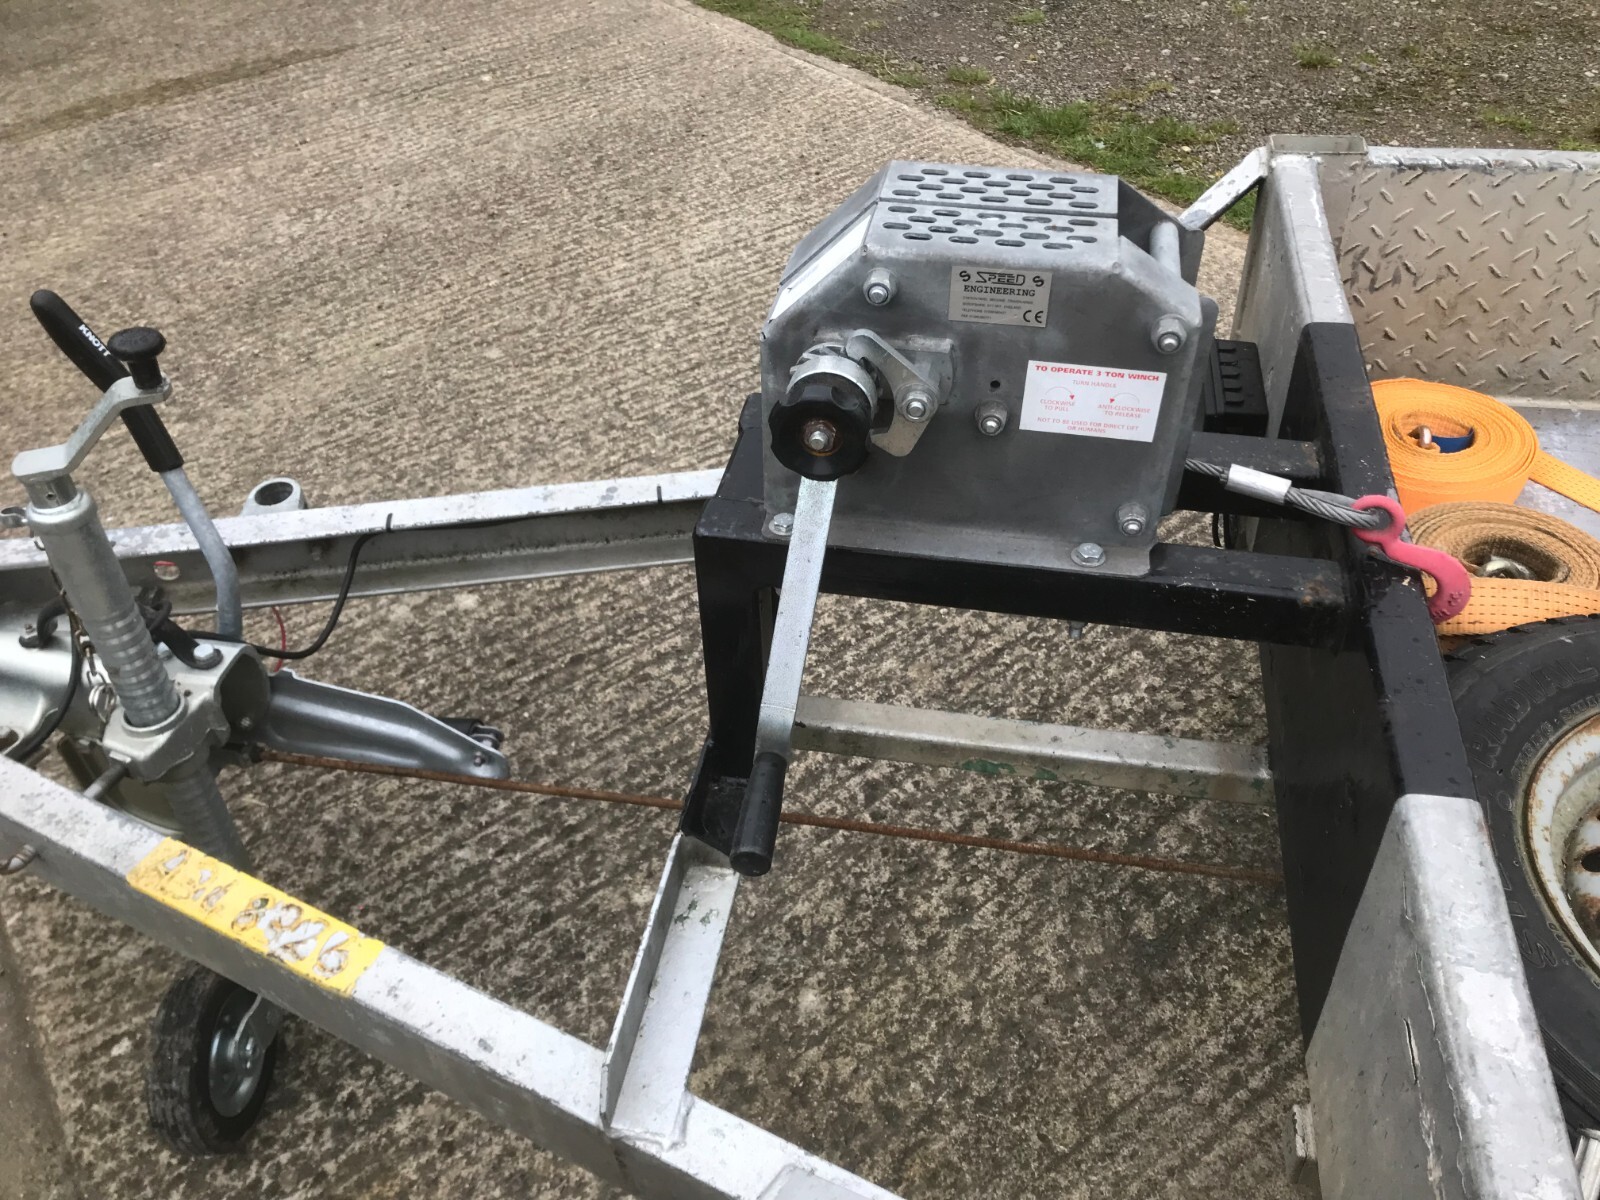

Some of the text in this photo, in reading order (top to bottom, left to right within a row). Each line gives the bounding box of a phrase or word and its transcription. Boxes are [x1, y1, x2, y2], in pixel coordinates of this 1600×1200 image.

[975, 271, 1026, 286] SPEED
[963, 284, 1036, 297] ENGINEERING
[1023, 309, 1044, 323] CE
[79, 324, 111, 356] KNOTT
[1050, 367, 1094, 376] OPERATE
[1105, 371, 1125, 379] TON
[1128, 373, 1160, 381] WINCH
[1040, 398, 1076, 407] CLOCKWISE
[1097, 404, 1151, 414] ANTI-CLOCKWISE
[1115, 411, 1142, 419] RELEASE
